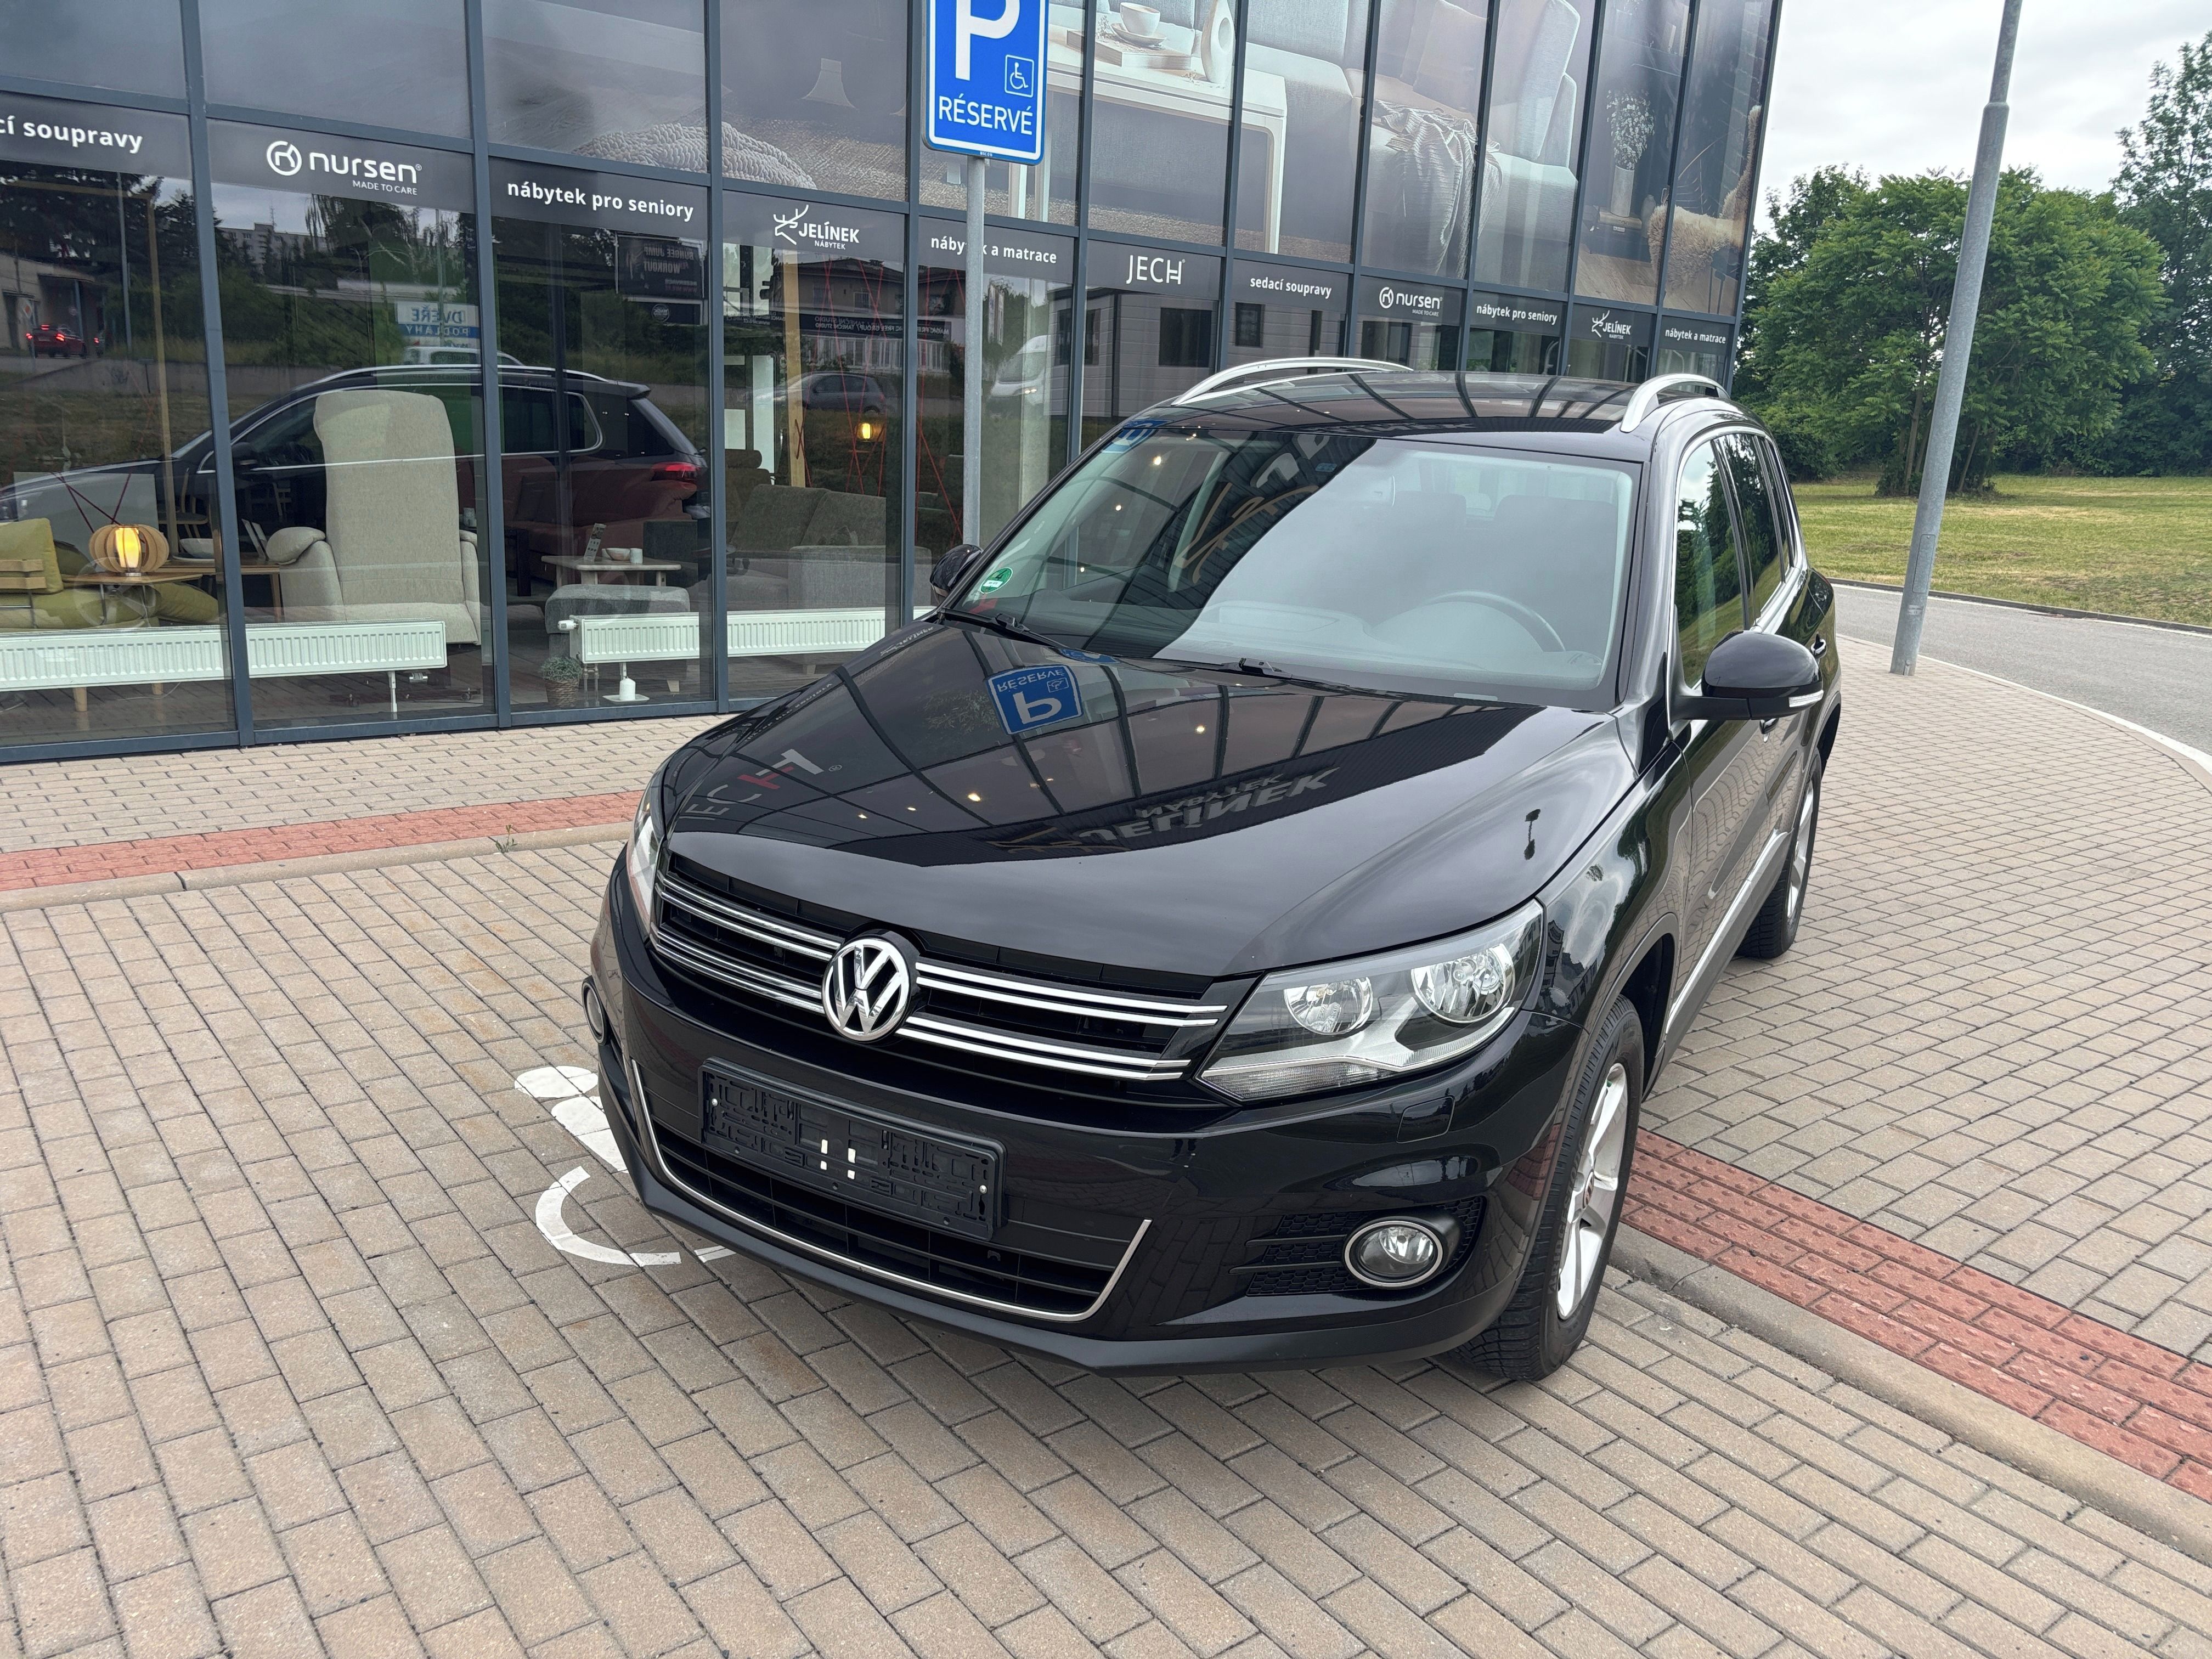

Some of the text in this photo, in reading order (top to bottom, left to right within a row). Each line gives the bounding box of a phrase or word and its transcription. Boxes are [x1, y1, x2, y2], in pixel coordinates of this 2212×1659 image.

[955, 0, 1020, 81] P
[939, 93, 1033, 136] RÉSERVÉ
[23, 122, 143, 154] soupravy
[353, 179, 417, 195] MADE TO CARE
[507, 181, 694, 222] nábytek pro seniory
[798, 221, 860, 243] JELÍNEK
[814, 240, 846, 250] NÁBYTEK
[991, 246, 998, 256] a
[1003, 247, 1057, 264] matrace
[1250, 276, 1332, 300] sedací soupravy
[1476, 303, 1558, 325] nábytek pro seniory
[1602, 320, 1632, 335] JELÍNEK
[1665, 328, 1693, 341] nábytek
[1699, 334, 1726, 344] matrace
